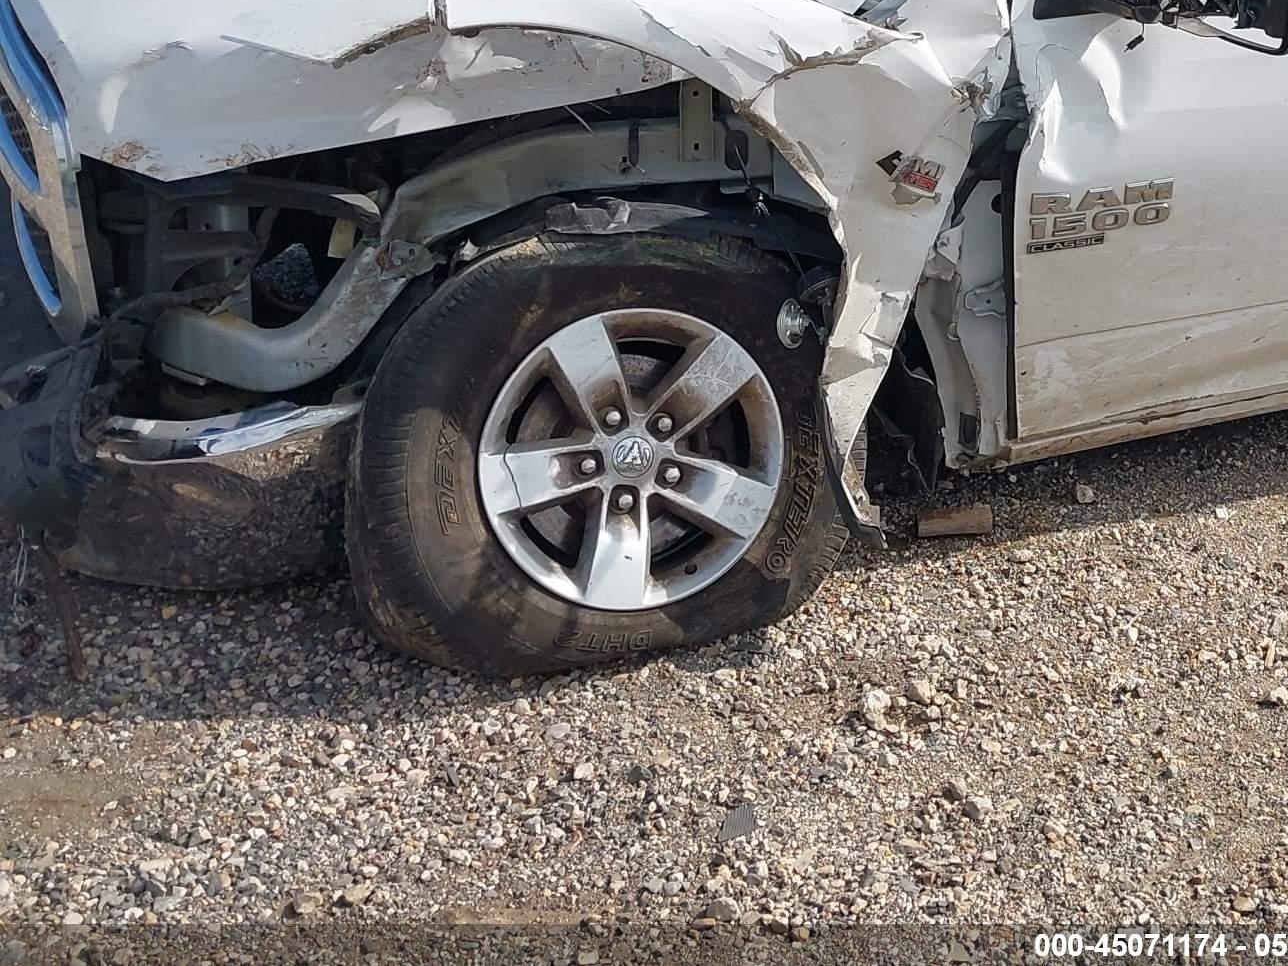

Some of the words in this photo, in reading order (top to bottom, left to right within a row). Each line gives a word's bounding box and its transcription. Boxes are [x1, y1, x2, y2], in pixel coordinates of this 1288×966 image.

[1030, 177, 1175, 215] RAM
[1029, 202, 1171, 240] 1500
[1029, 234, 1104, 253] CLASSIC
[553, 628, 653, 653] DHT2
